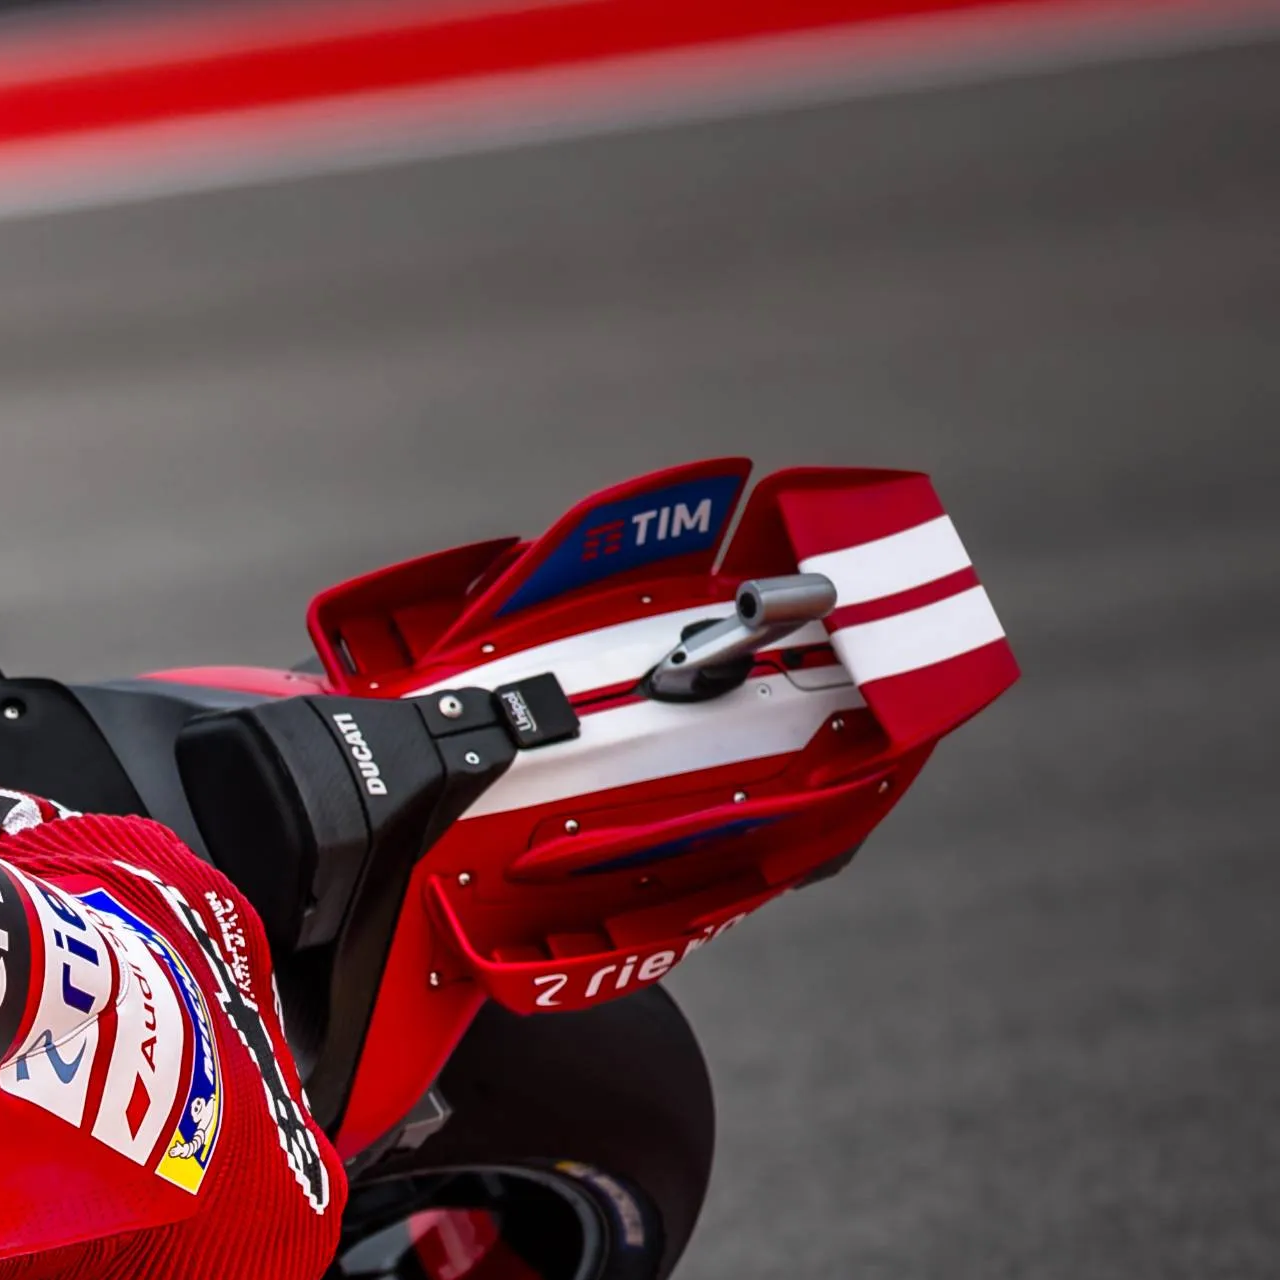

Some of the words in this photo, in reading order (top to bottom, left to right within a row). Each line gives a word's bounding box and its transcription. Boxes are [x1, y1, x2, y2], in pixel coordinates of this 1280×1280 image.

[632, 499, 712, 546] TIM
[332, 712, 388, 796] DUCATI
[35, 882, 100, 1015] rie
